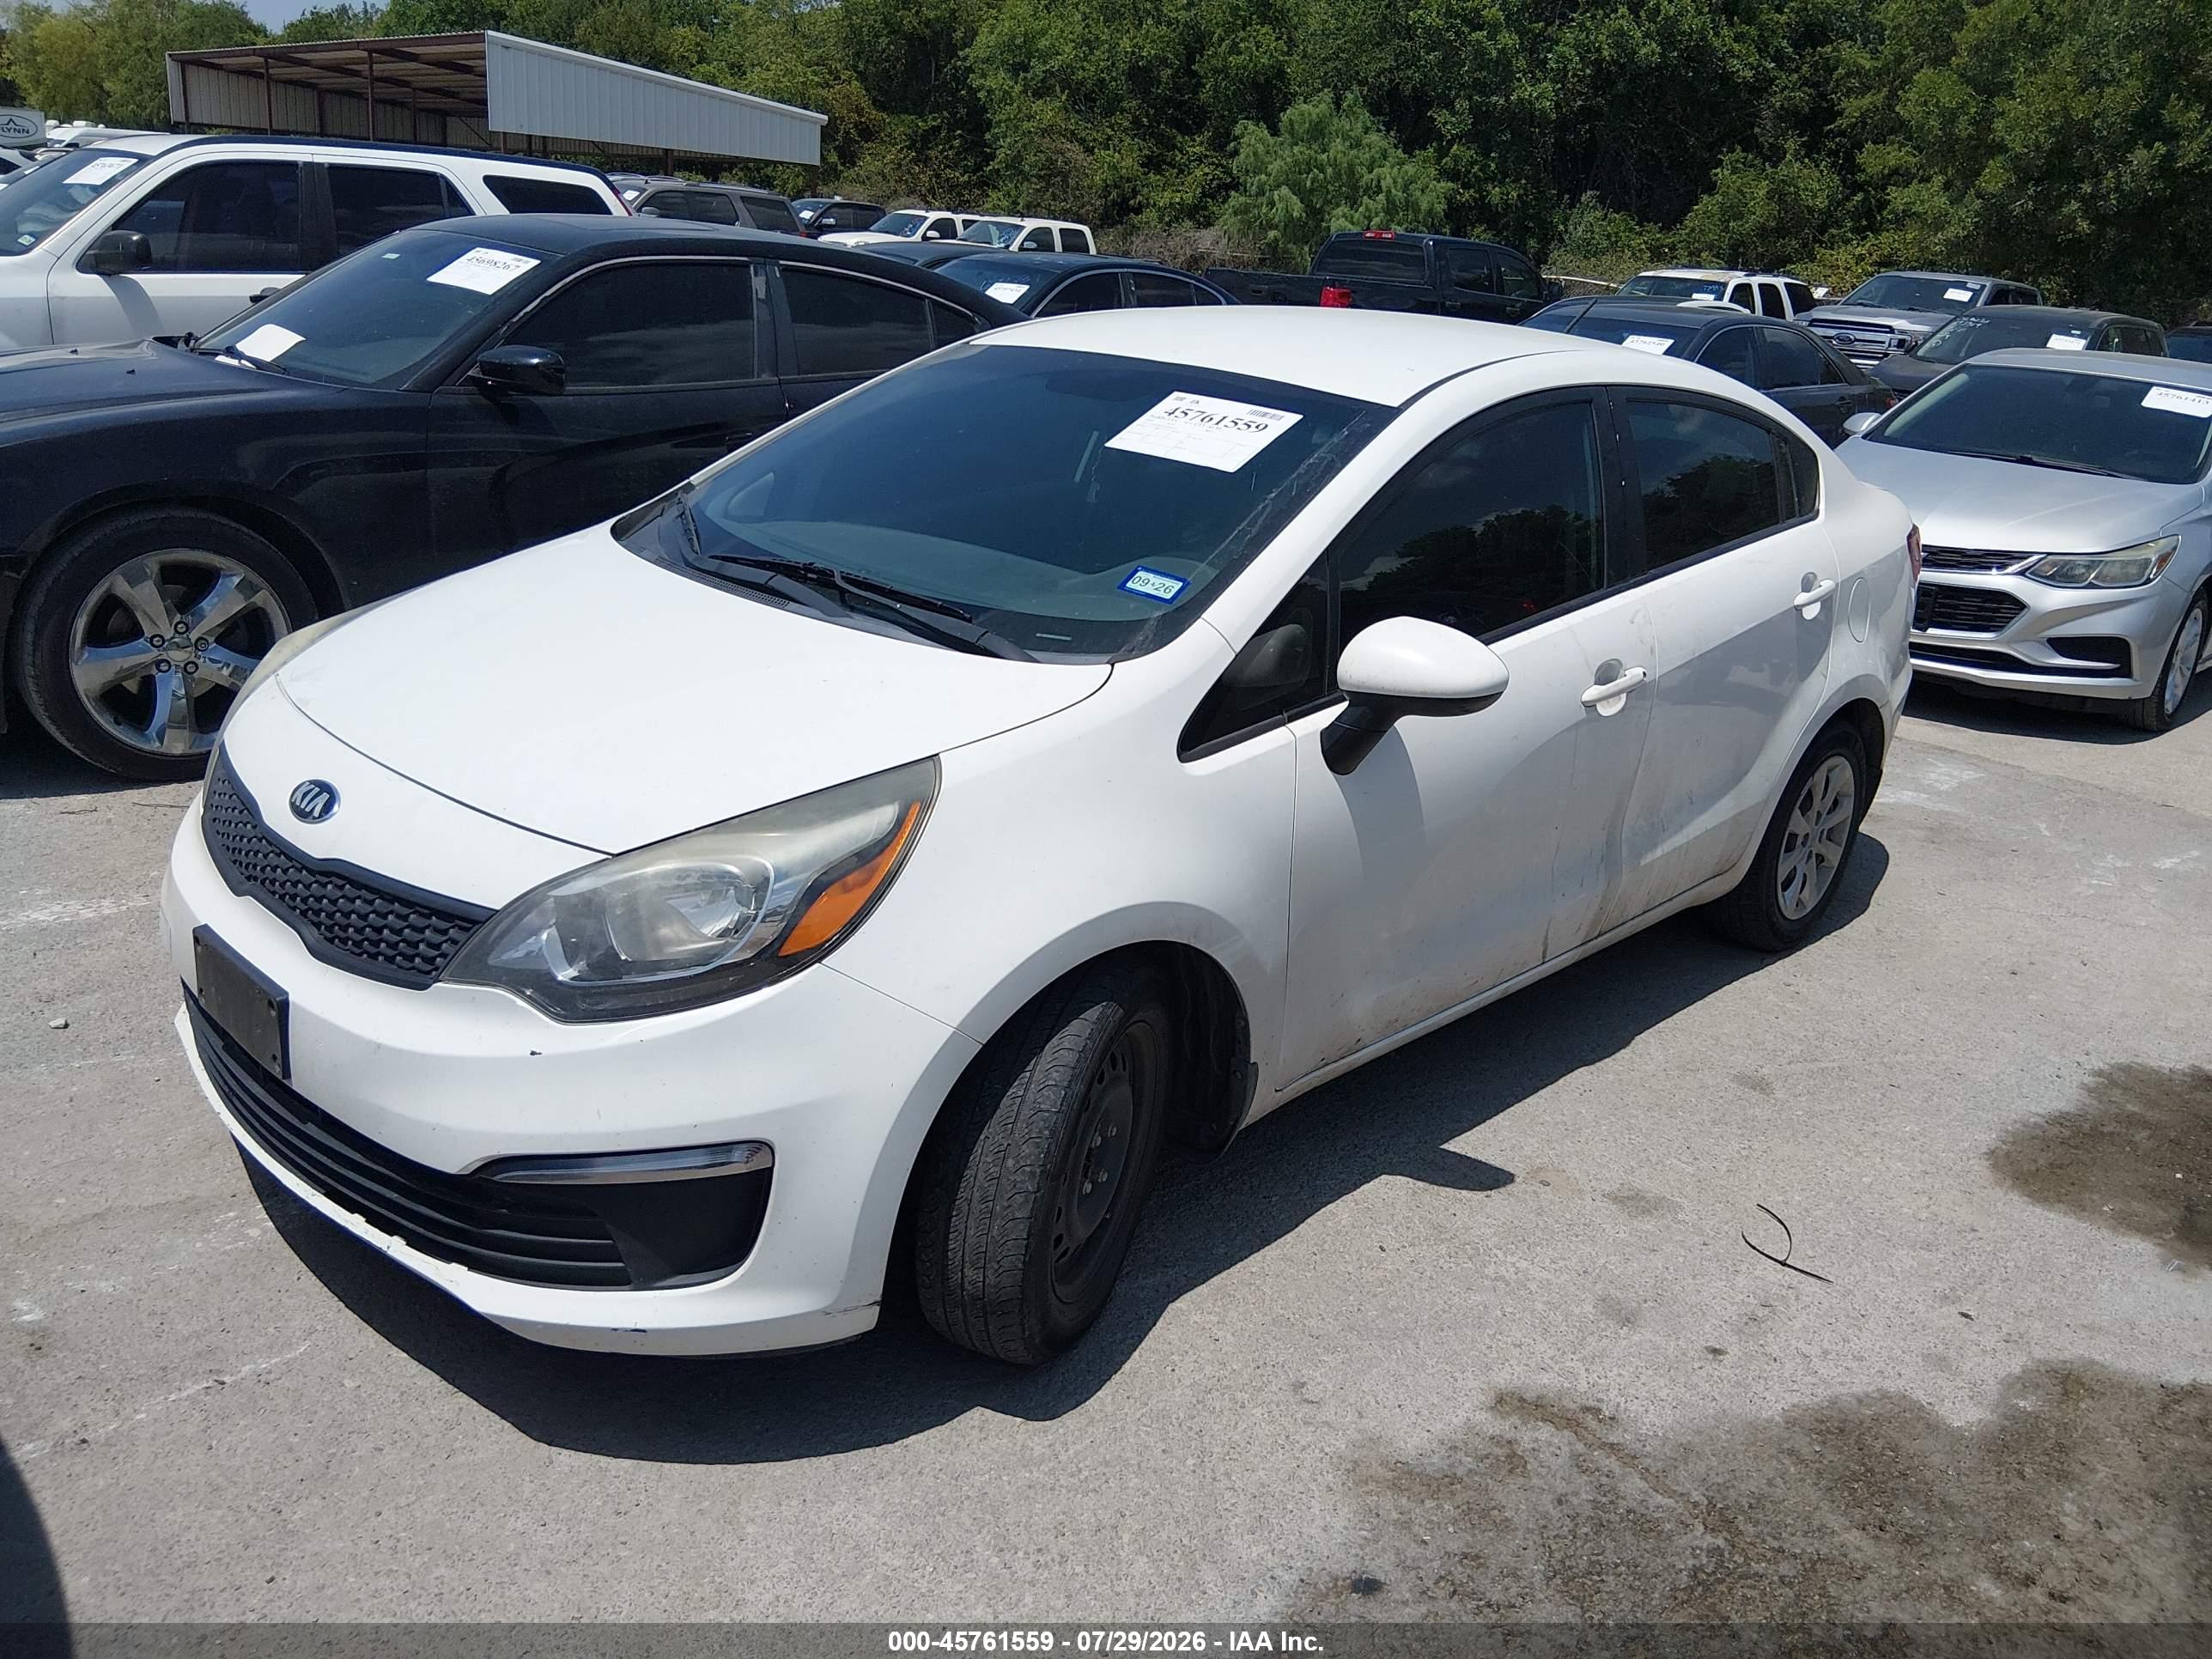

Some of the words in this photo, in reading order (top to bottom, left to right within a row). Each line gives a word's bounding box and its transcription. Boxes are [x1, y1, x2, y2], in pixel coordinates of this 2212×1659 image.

[0, 126, 30, 135] LYNN
[1164, 406, 1269, 434] 45761559
[291, 781, 331, 818] KIA
